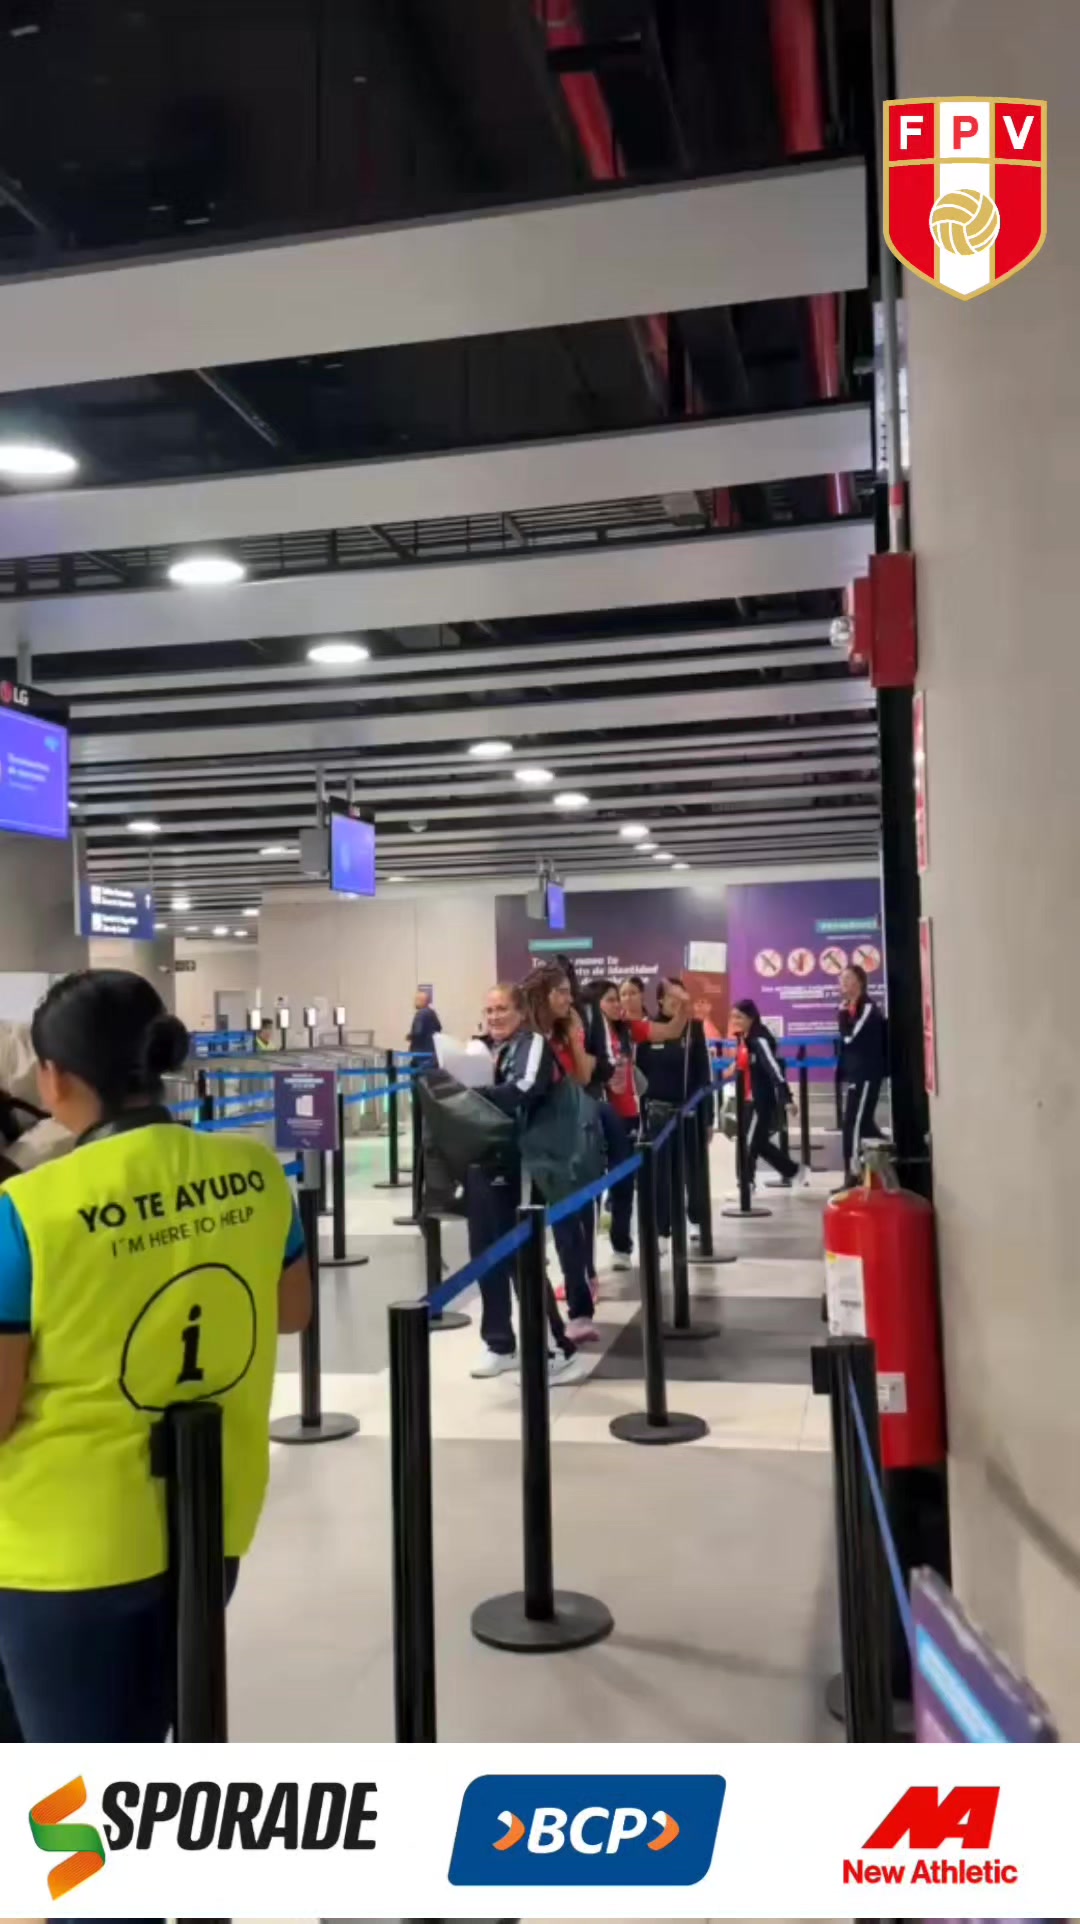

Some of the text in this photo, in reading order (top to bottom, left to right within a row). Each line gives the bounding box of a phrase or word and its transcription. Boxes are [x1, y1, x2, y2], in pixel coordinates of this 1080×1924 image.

[13, 686, 29, 706] LG
[78, 1169, 265, 1233] YO TE AYUDO
[148, 1222, 191, 1248] HERE
[193, 1216, 216, 1237] TO
[220, 1206, 254, 1228] HELP
